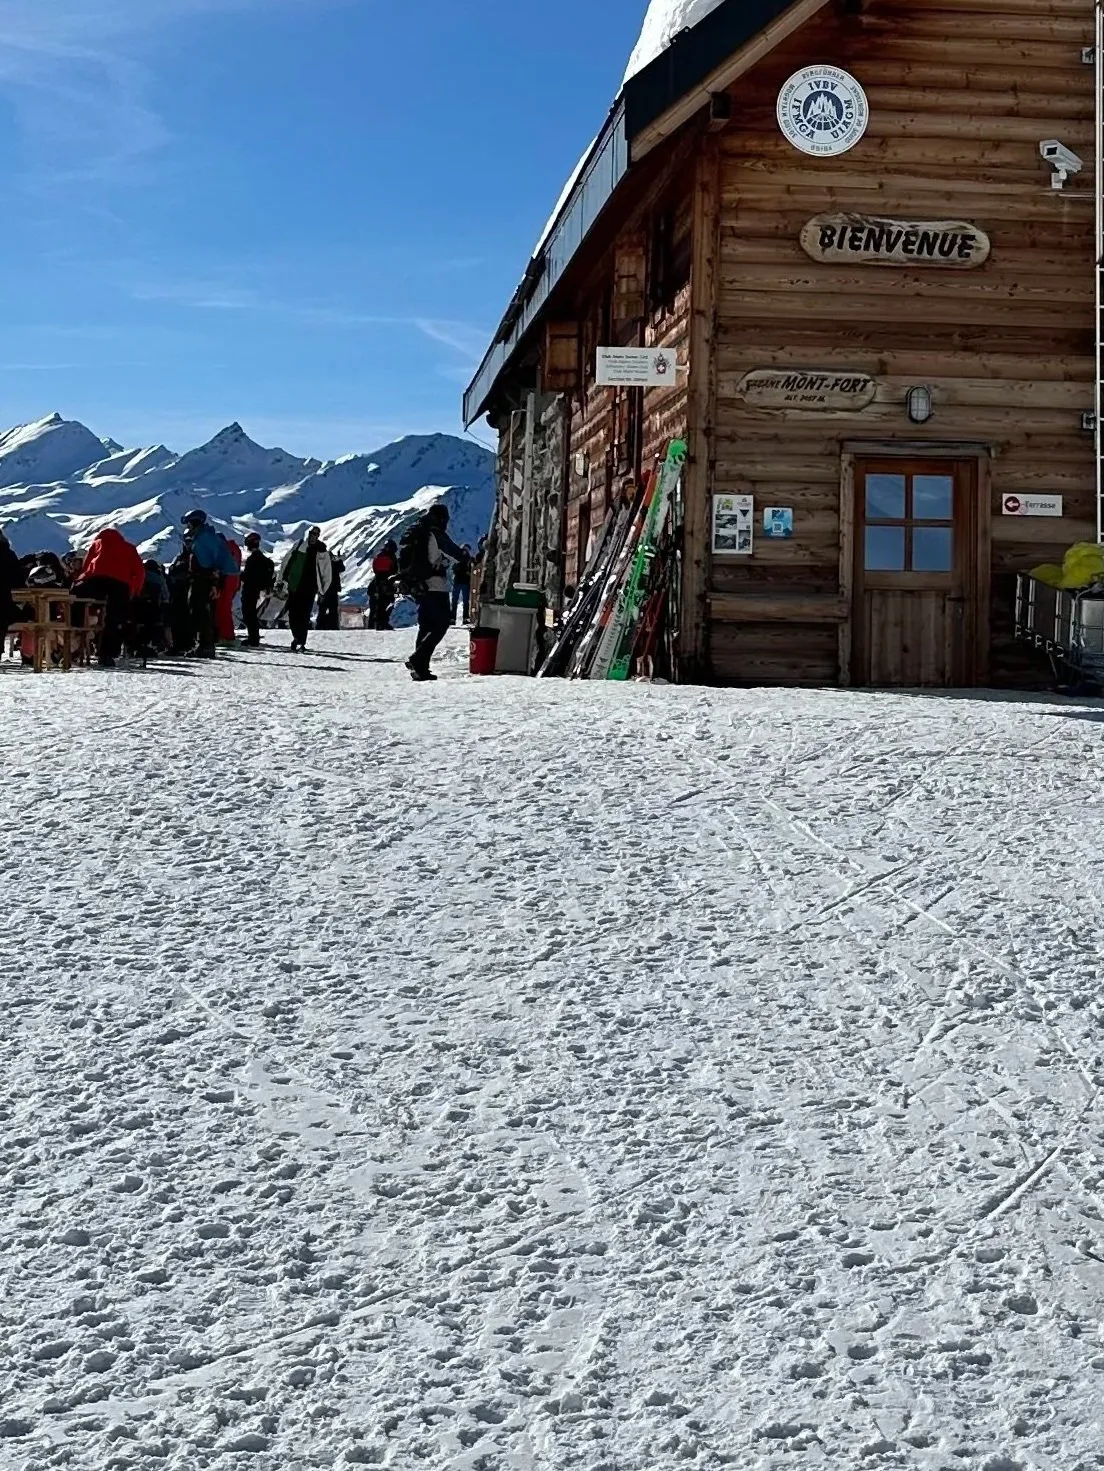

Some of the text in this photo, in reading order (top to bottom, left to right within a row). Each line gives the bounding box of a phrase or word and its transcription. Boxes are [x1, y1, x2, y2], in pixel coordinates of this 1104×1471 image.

[808, 80, 838, 91] IVBV
[792, 98, 815, 139] IFMGA
[831, 99, 853, 139] UIAGM
[818, 224, 976, 258] BIENVENUE
[781, 375, 872, 393] MONT-FORT
[1025, 500, 1056, 509] Terrasse
